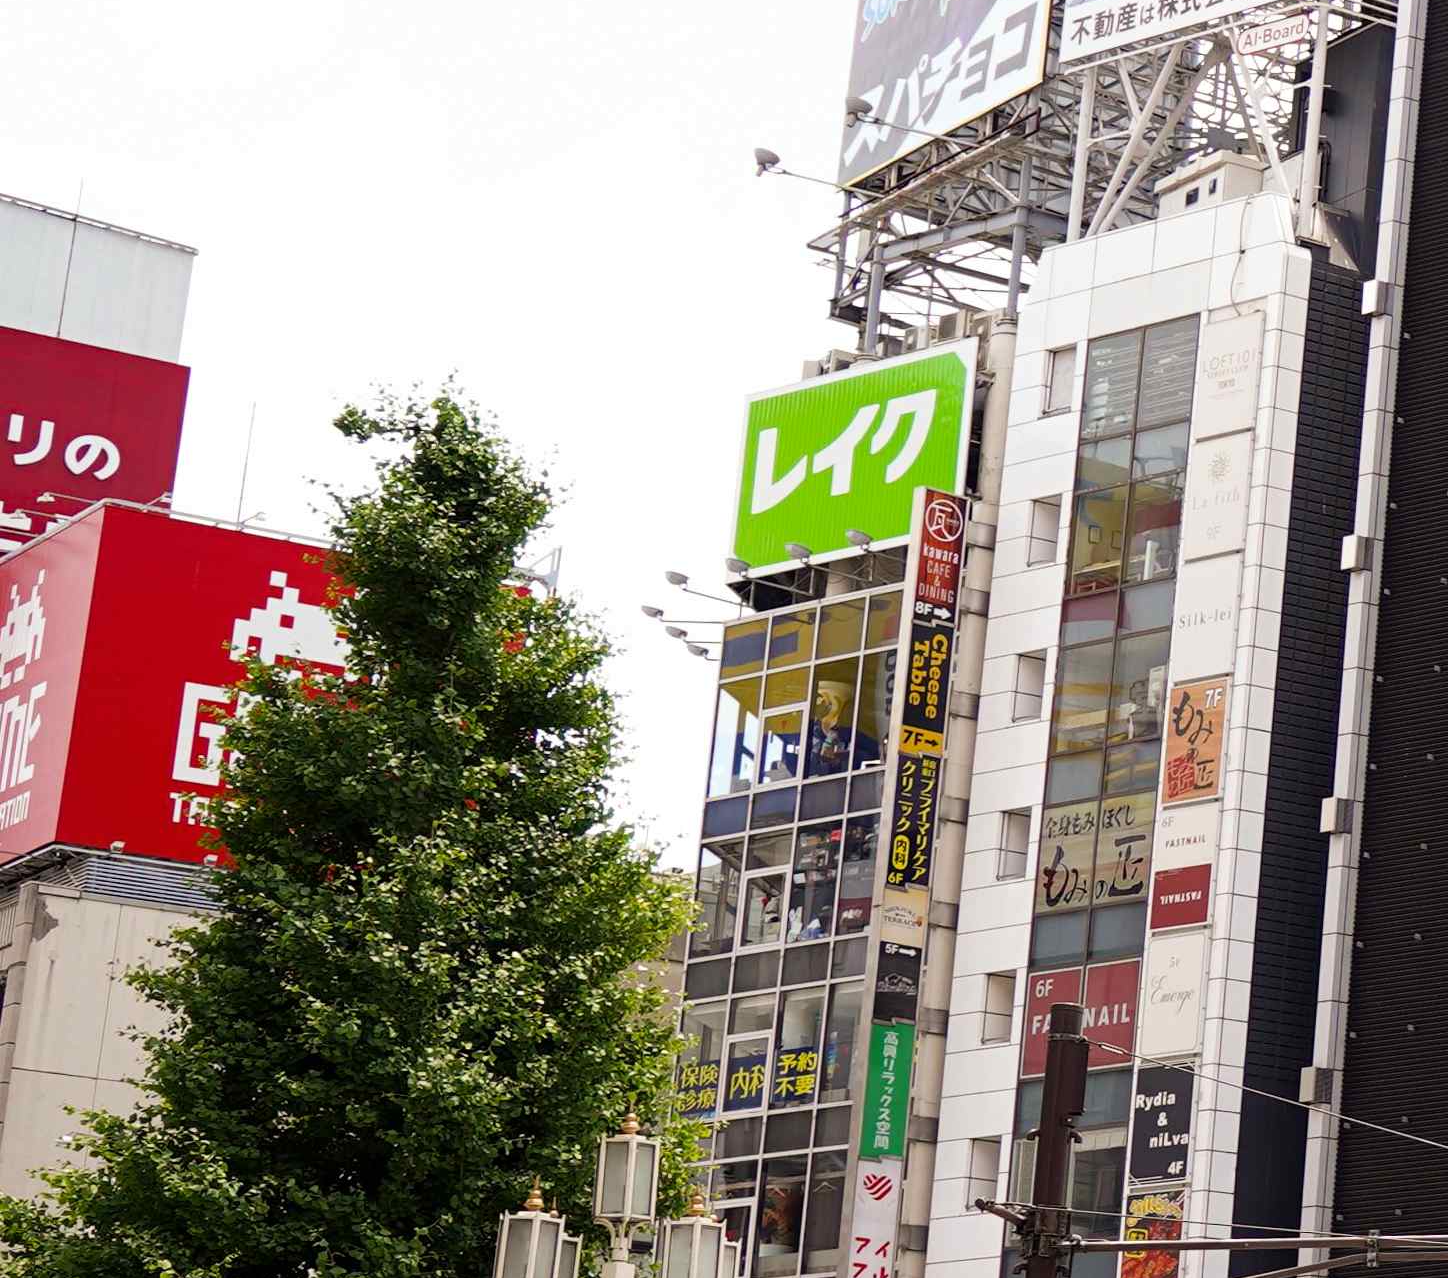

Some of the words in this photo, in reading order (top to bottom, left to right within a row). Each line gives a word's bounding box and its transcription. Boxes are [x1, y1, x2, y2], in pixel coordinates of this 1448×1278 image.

[844, 1, 1041, 165] スパチョコ
[750, 386, 938, 516] レイク
[923, 542, 959, 565] kawara
[927, 560, 950, 579] CAFE
[918, 582, 955, 603] DINING
[915, 601, 933, 616] 8F
[908, 640, 930, 706] Table
[925, 633, 948, 720] Cheese
[1205, 687, 1224, 710] 7F
[903, 730, 924, 746] 7F
[896, 760, 915, 833] クリニック
[1165, 834, 1207, 850] FASTNAIL
[888, 874, 904, 884] 6F
[1042, 834, 1147, 908] もみの匠
[885, 944, 899, 954] 5F
[1035, 979, 1054, 999] 6F
[1031, 1002, 1130, 1036] FANAIL
[778, 1052, 817, 1074] 予約
[681, 1064, 719, 1089] 保険
[729, 1065, 767, 1099] 内科
[775, 1074, 816, 1097] 不要
[1135, 1093, 1176, 1113] Rydia
[1156, 1113, 1168, 1126] &
[1168, 1161, 1184, 1175] 4F
